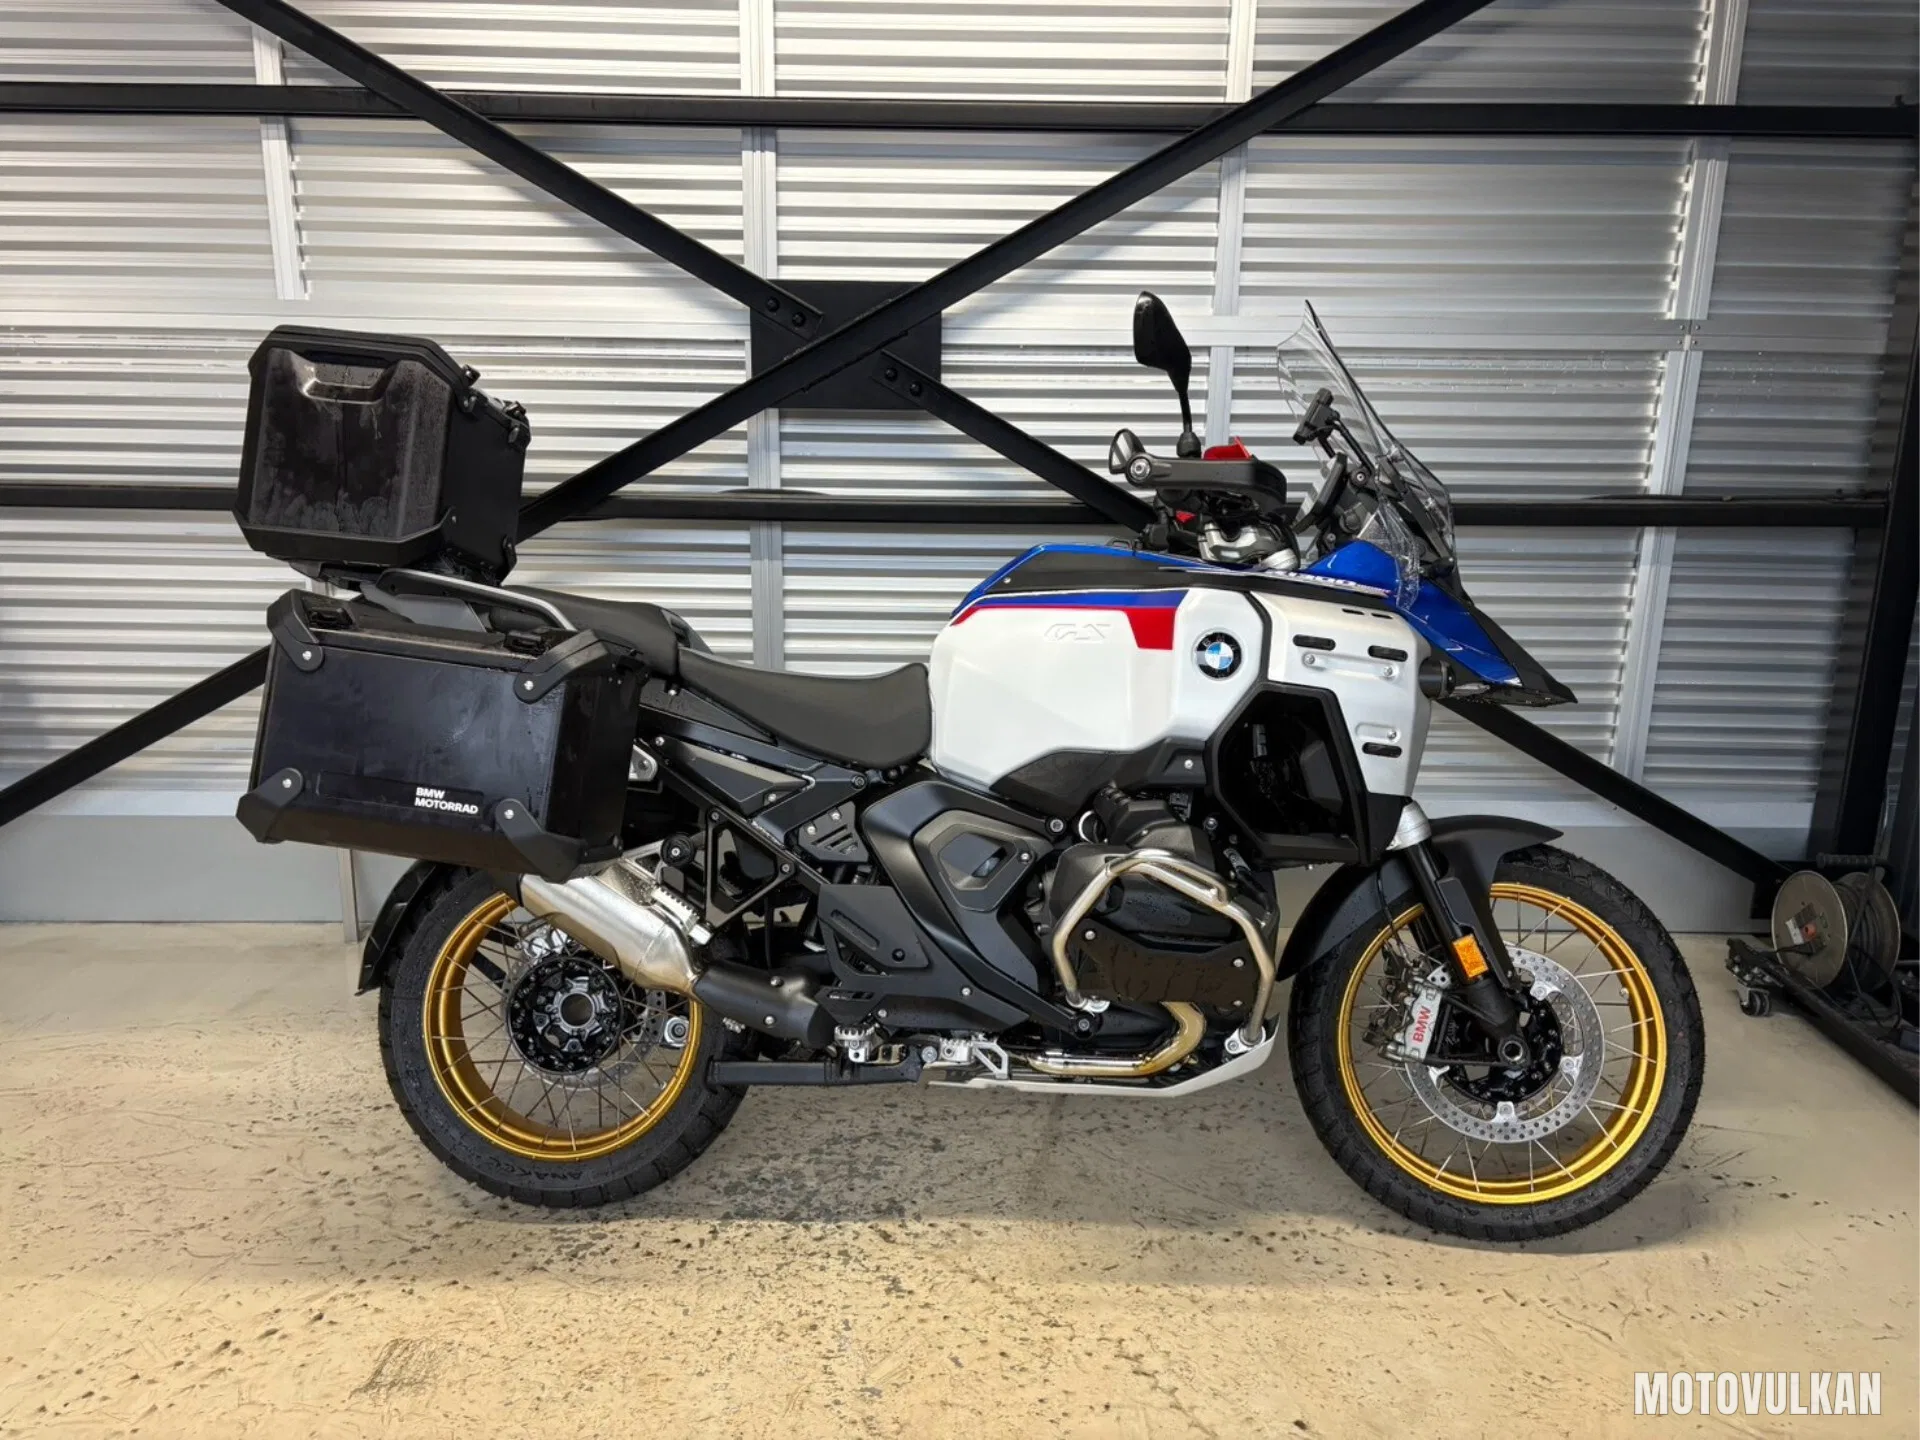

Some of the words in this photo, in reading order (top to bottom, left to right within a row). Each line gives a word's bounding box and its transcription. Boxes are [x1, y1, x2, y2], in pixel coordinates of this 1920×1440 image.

[416, 787, 446, 799] BMW
[414, 797, 479, 814] MOTORRAD
[1413, 1005, 1431, 1042] BMW
